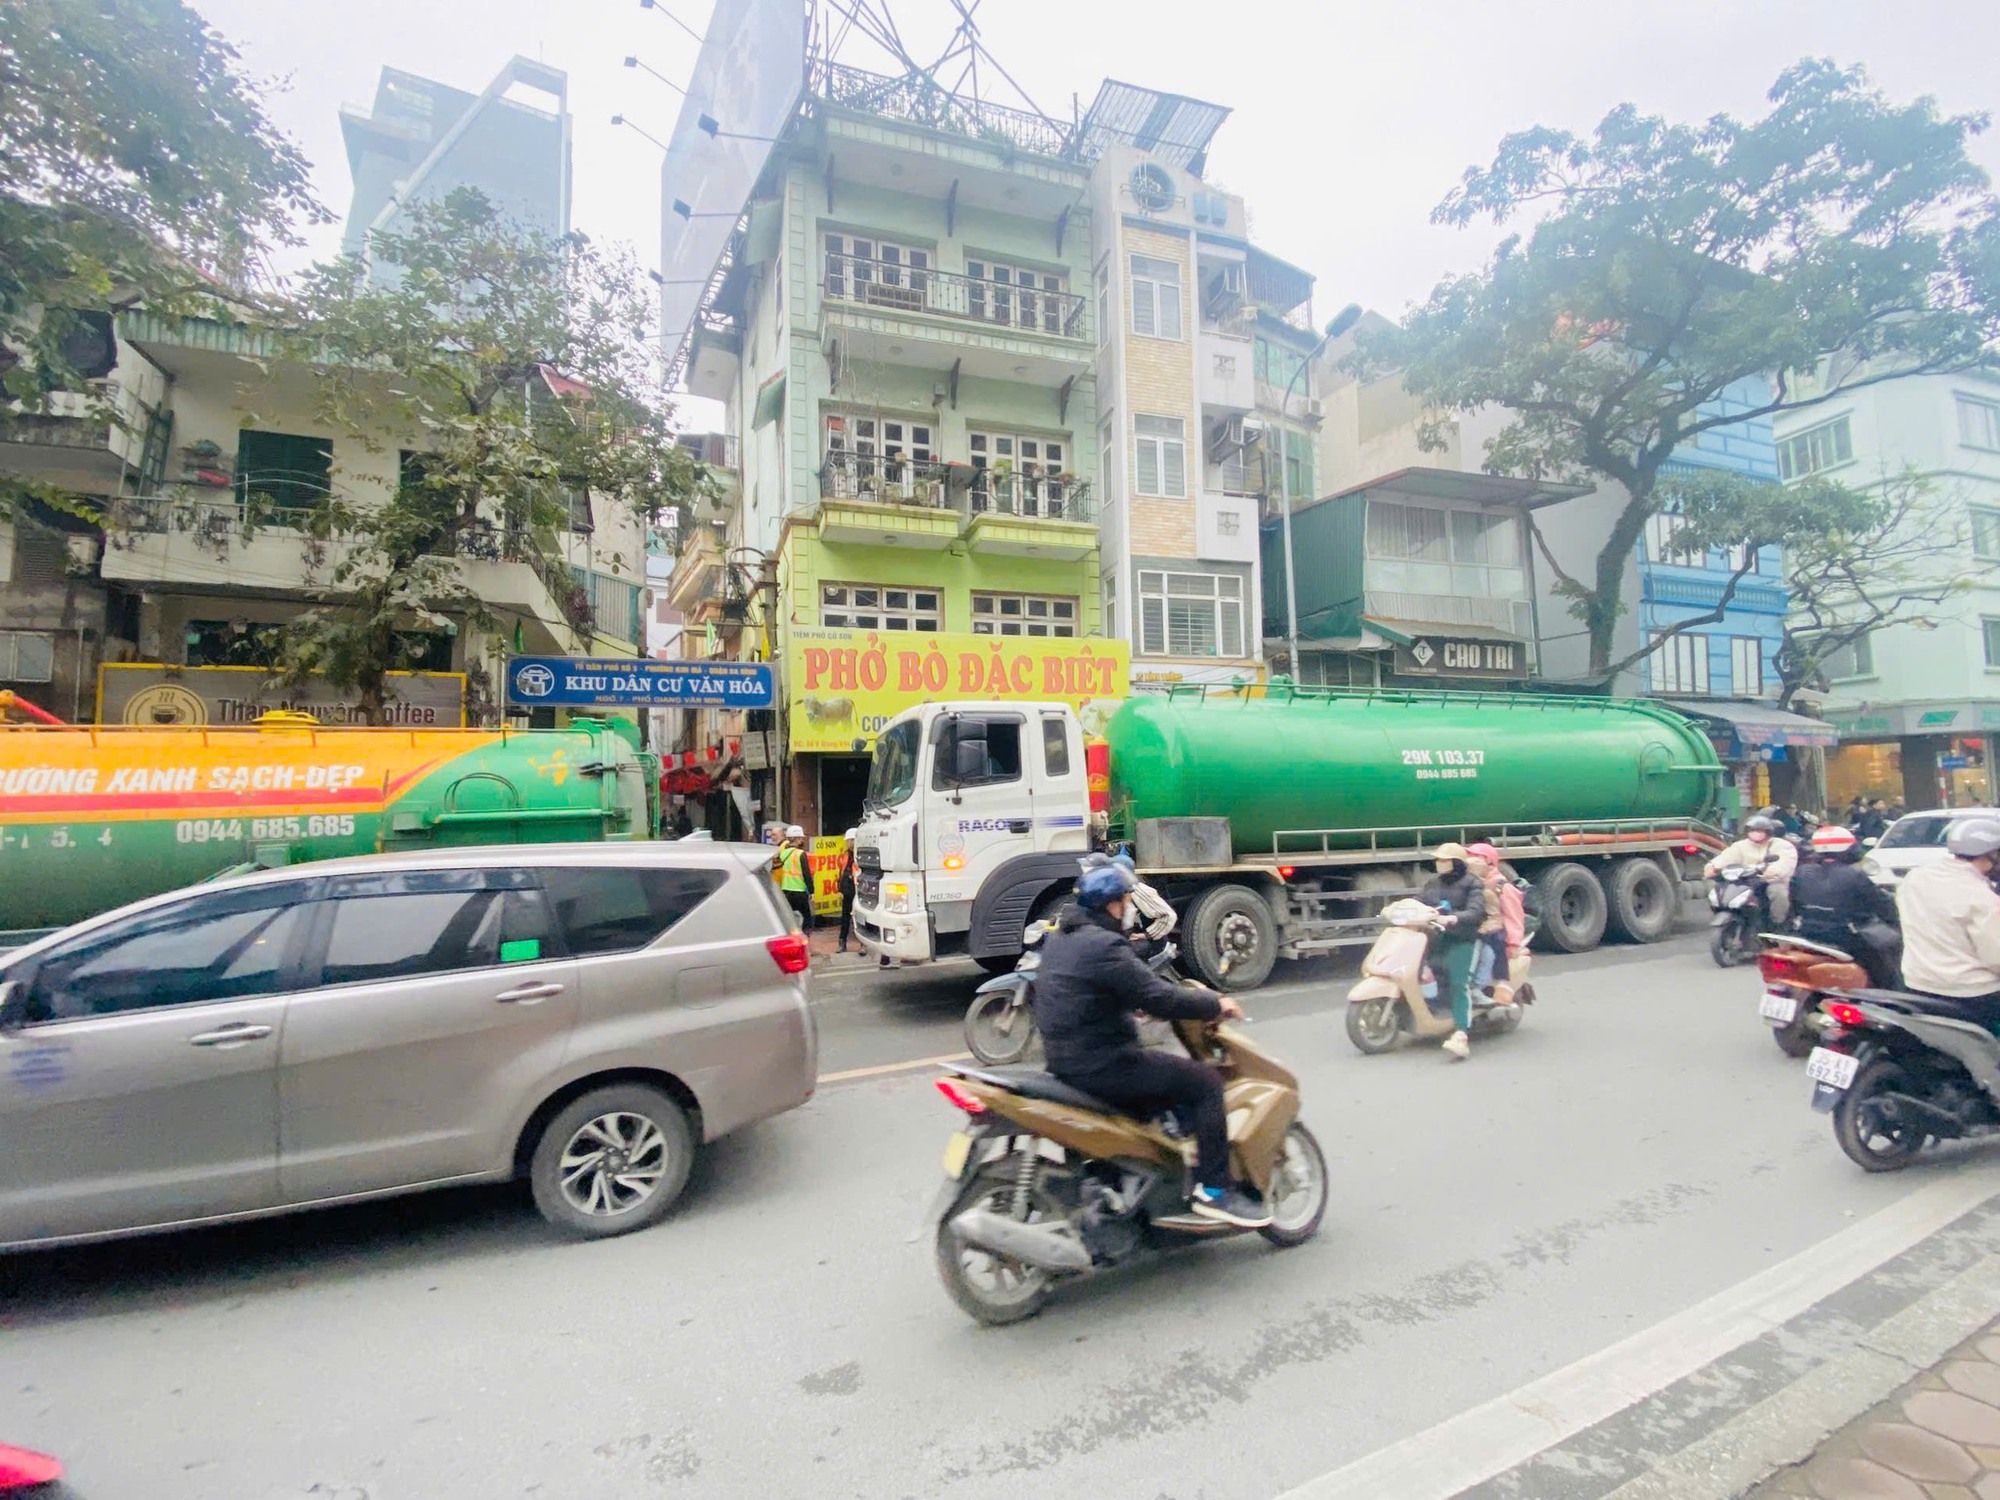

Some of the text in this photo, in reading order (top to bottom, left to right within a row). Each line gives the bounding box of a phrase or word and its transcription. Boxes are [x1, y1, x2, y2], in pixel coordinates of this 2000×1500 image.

[1444, 643, 1480, 668] CAO
[803, 631, 1118, 709] PHỞ BÒ ĐẶC BIỆT
[565, 673, 766, 695] KHU DÂN CƯ VĂN HÓA
[384, 702, 436, 724] offee
[1401, 749, 1485, 766] 29K 103.37
[106, 767, 198, 793] XANH
[176, 814, 356, 844] 0944 685.685
